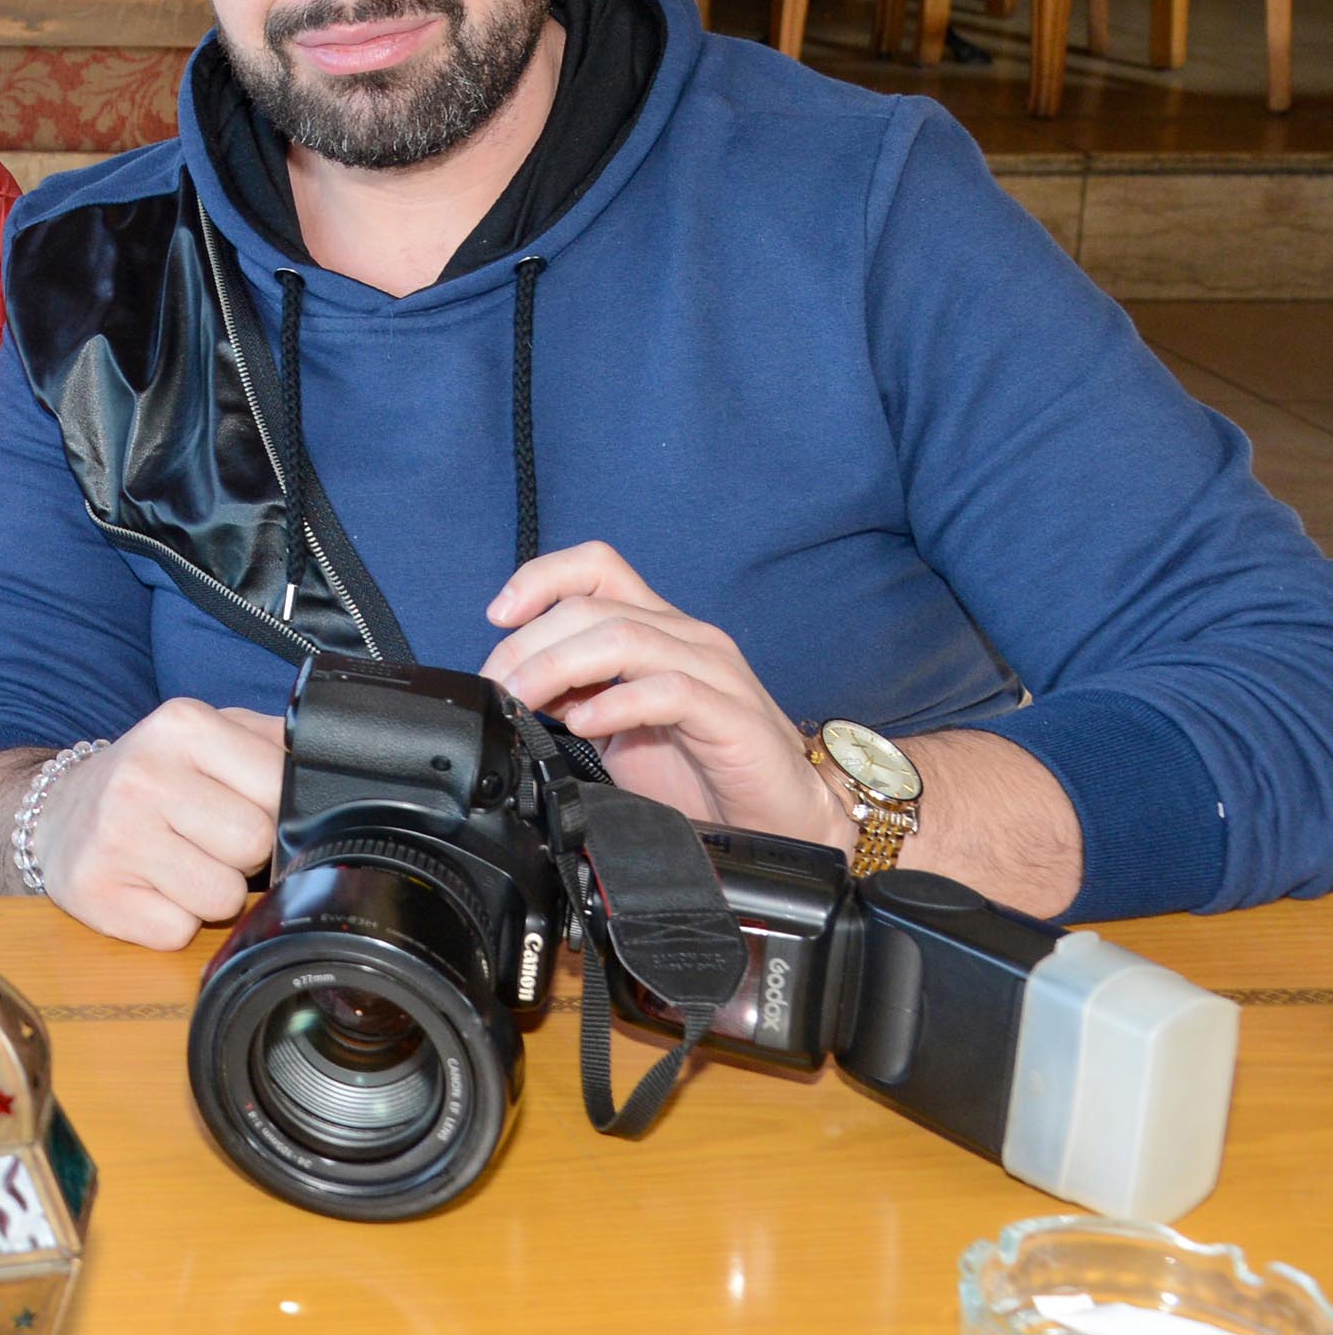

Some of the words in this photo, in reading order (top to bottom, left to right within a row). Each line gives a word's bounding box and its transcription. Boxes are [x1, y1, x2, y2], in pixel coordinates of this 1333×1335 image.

[517, 932, 544, 1001] Canon
[762, 957, 791, 1032] Godox
[447, 1058, 462, 1098] CANON
